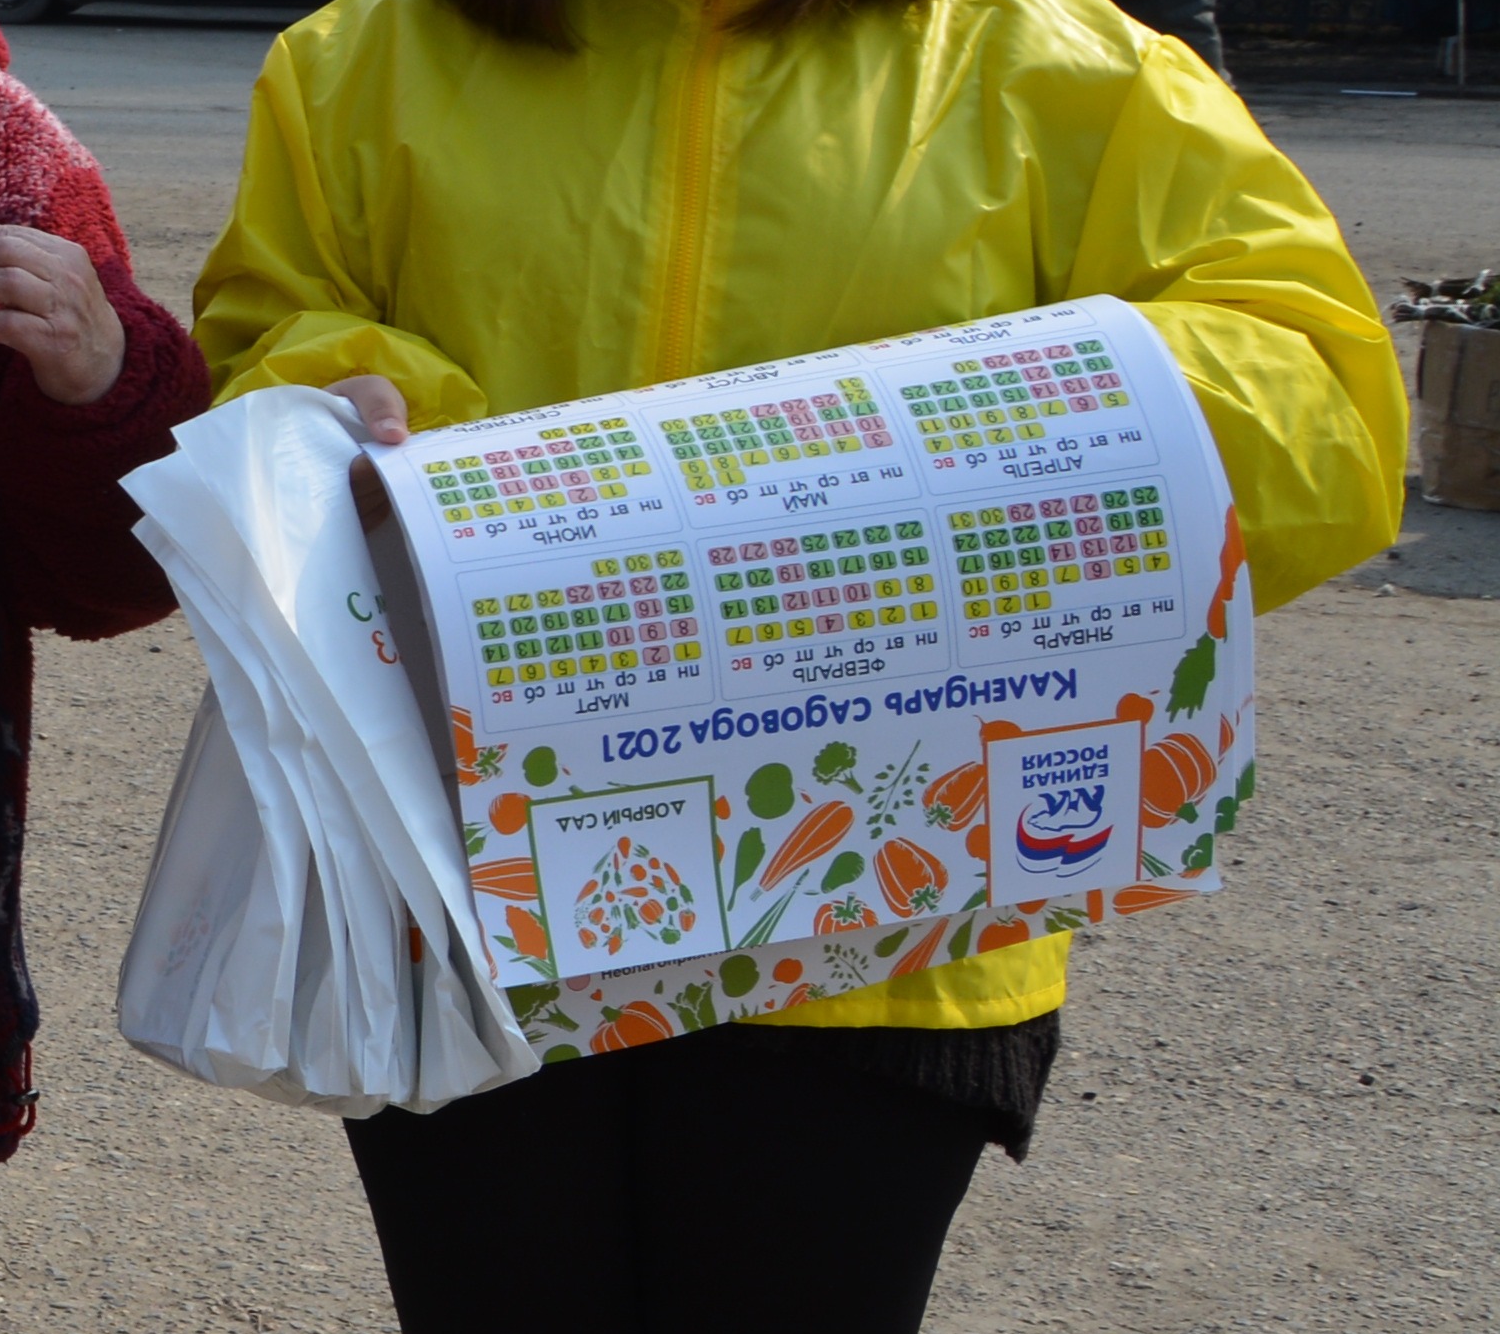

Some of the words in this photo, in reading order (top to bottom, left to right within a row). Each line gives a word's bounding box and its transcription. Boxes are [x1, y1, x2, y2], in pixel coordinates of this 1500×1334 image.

[1002, 454, 1083, 478] АПРЕЛЬ
[781, 491, 829, 511] МАЙ
[531, 523, 597, 545] ИЮНЬ
[1032, 627, 1114, 650] ЯНВАРЬ
[791, 657, 886, 683] ФЕВРАЛЬ
[574, 691, 630, 715] МАРТ
[601, 724, 682, 763] 2021
[1021, 743, 1109, 771] РОССИЯ
[1021, 762, 1109, 790] ЕДИНАЯ
[554, 812, 598, 833] САД
[601, 798, 687, 827] ДОБРЫЙ
